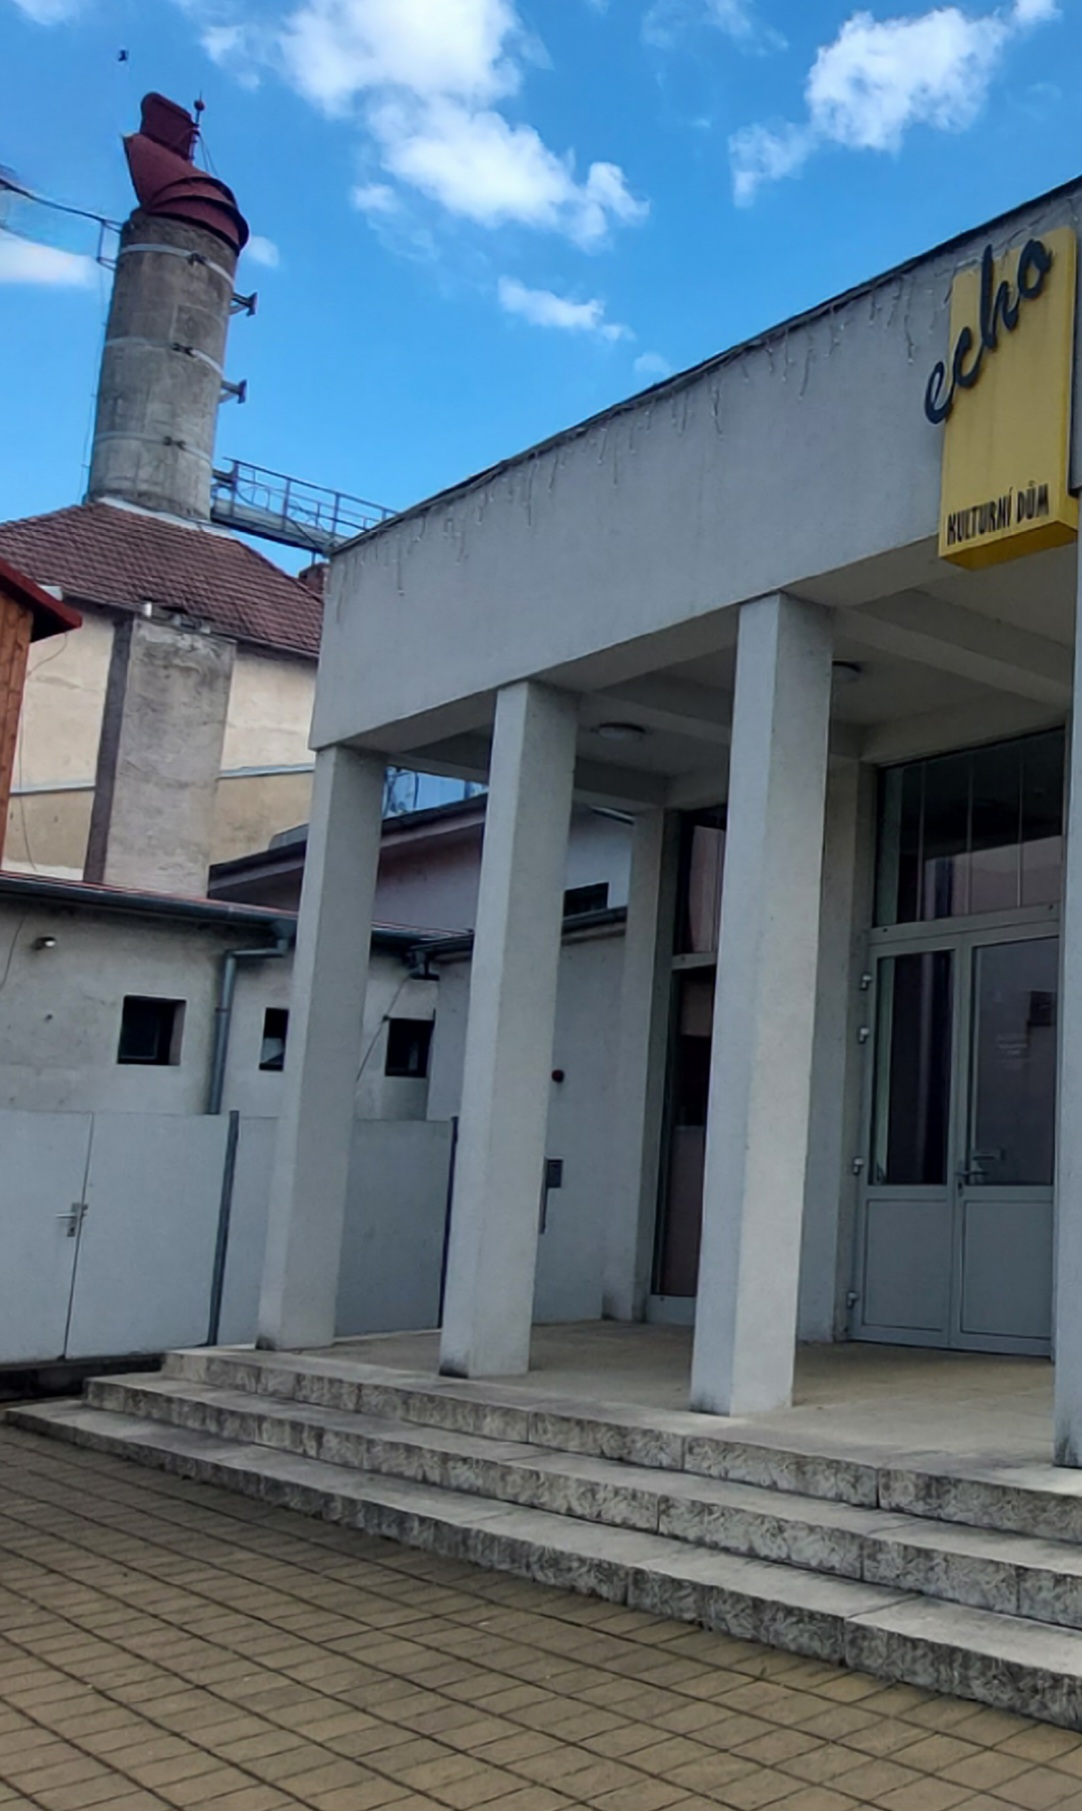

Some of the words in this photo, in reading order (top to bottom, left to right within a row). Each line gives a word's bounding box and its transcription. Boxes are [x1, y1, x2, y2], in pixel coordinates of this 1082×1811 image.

[924, 239, 1052, 424] echo
[947, 486, 1014, 545] KULTURNÍ
[1017, 480, 1050, 524] DŮM
